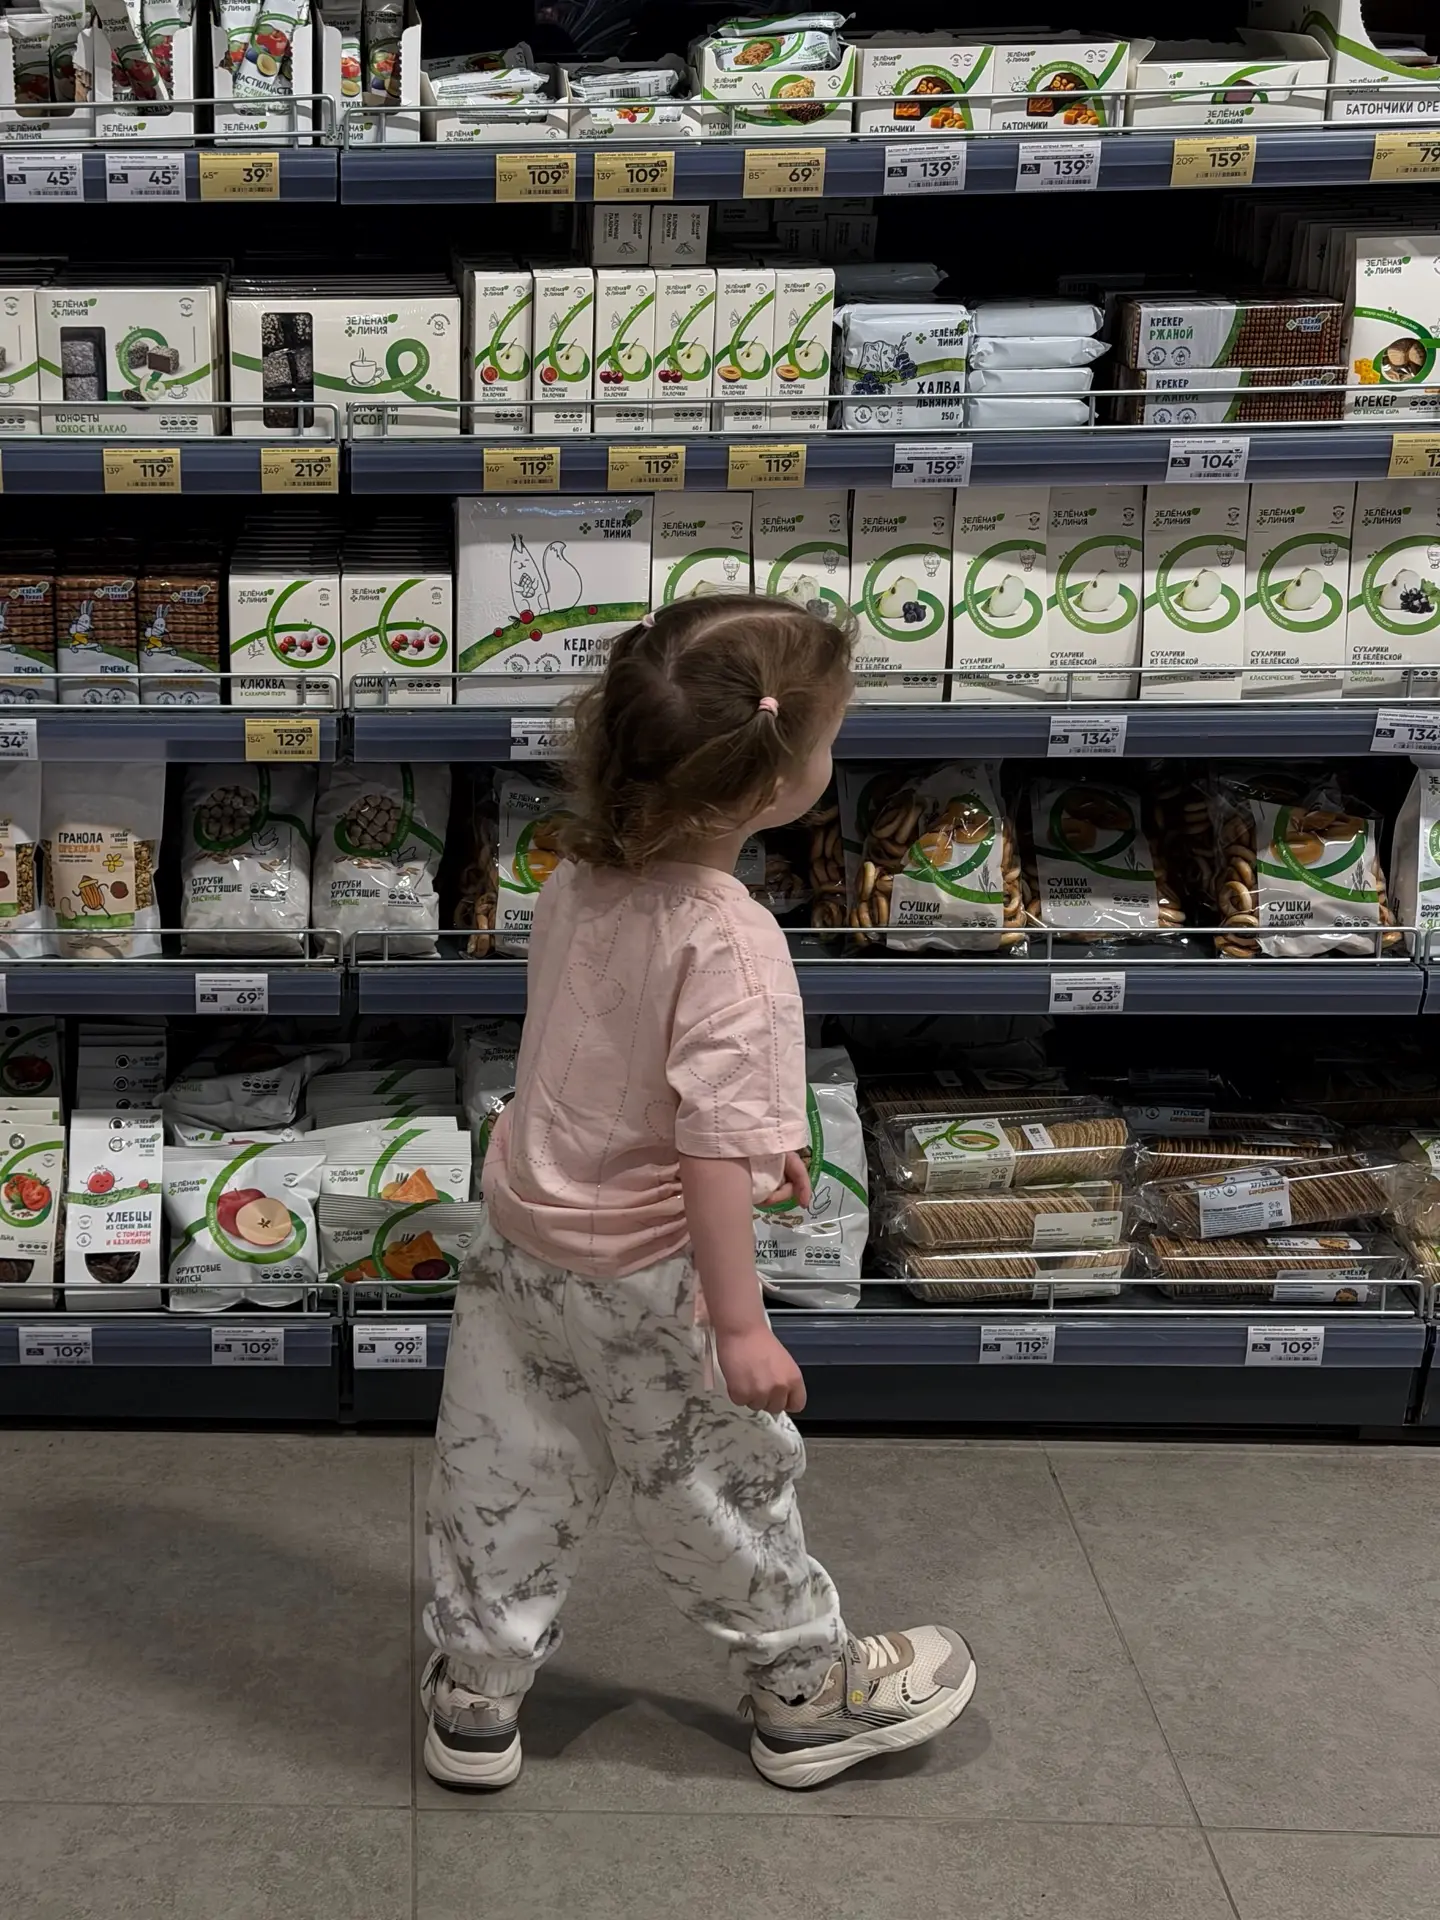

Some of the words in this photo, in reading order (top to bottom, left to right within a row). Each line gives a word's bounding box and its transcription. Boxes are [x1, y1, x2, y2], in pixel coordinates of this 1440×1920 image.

[1207, 110, 1244, 118] ЗЕЛЁНАЯ
[1346, 102, 1414, 116] БАТОНЧИКИ
[6, 122, 42, 132] ЗЕЛЁНАЯ
[102, 124, 138, 132] ЗЕЛЁНАЯ
[223, 123, 258, 131] ЗЕЛЁНАЯ
[1002, 122, 1048, 130] БАТОНЧИКИ
[1209, 152, 1241, 167] 159
[920, 162, 951, 177] 139
[1054, 161, 1085, 175] 139
[47, 172, 69, 185] 45
[149, 171, 171, 185] 45
[243, 168, 265, 182] 39
[529, 171, 561, 184] 109
[627, 168, 660, 182] 109
[788, 168, 812, 182] 69
[1376, 266, 1402, 274] ЛИНИЯ
[52, 300, 88, 308] ЗЕЛЁНАЯ
[61, 308, 88, 316] ЛИНИЯ
[346, 316, 388, 324] ЗЕЛЁНАЯ
[1150, 317, 1183, 327] КРЕКЕР
[356, 326, 388, 335] ЛИНИЯ
[929, 328, 963, 338] ЗЕЛЁНАЯ
[1149, 327, 1193, 340] РЖАНОЙ
[938, 337, 963, 346] ЛИНИЯ
[917, 380, 960, 393] ХАЛВА
[1156, 379, 1189, 389] КРЕКЕР
[1354, 395, 1397, 407] КРЕКЕР
[55, 414, 99, 423] КОНФЕТЫ
[941, 411, 955, 421] 250
[56, 425, 86, 433] КОКОС
[89, 425, 96, 433] И
[98, 424, 127, 433] КАКАО
[766, 460, 792, 472] 119
[1201, 455, 1233, 468] 104
[140, 465, 166, 477] 119
[295, 464, 324, 477] 219
[520, 462, 546, 475] 119
[645, 461, 671, 474] 119
[927, 461, 956, 474] 159
[1052, 510, 1088, 518] ЗЕЛЁНАЯ
[1155, 509, 1191, 518] ЗЕЛЁНАЯ
[1259, 508, 1296, 517] ЗЕЛЁНАЯ
[1364, 508, 1401, 517] ЗЕЛЁНАЯ
[595, 520, 632, 529] ЗЕЛЁНАЯ
[761, 517, 795, 525] ЗЕЛЁНАЯ
[863, 517, 898, 525] ЗЕЛЁНАЯ
[962, 516, 996, 525] ЗЕЛЁНАЯ
[1062, 518, 1088, 526] ЛИНИЯ
[1267, 516, 1295, 524] ЛИНИЯ
[1373, 516, 1401, 525] ЛИНИЯ
[970, 524, 995, 532] ЛИНИЯ
[604, 529, 632, 539] ЛИНИЯ
[1353, 645, 1389, 654] СУХАРИКИ
[855, 656, 890, 664] СУХАРИКИ
[1159, 657, 1198, 665] БЕЛЁВСКОЙ
[1260, 656, 1300, 664] БЕЛЁВСКОЙ
[1352, 653, 1361, 661] ИЗ
[1363, 652, 1402, 661] БЕЛЁВСКОЙ
[100, 665, 129, 673] ПЕЧЕНЬЕ
[240, 678, 285, 690] КЛЮКВА
[277, 734, 305, 746] 129
[1082, 734, 1111, 744] 134
[1408, 729, 1437, 741] 134
[58, 832, 104, 844] ГРАНОЛА
[192, 876, 224, 886] ОТРУБИ
[331, 880, 362, 889] ОТРУБИ
[1047, 878, 1088, 887] СУШКИ
[192, 884, 243, 895] ХРУСТЯЩИЕ
[330, 888, 380, 899] ХРУСТЯЩИЕ
[899, 900, 940, 913] СУШКИ
[1268, 901, 1311, 912] СУШКИ
[1269, 912, 1314, 920] ЛАДОЖСКИЙ
[237, 993, 257, 1004] 69
[1093, 991, 1113, 1002] 63
[169, 1179, 200, 1189] ЗЕЛЁНАЯ
[177, 1185, 200, 1194] ЛИНИЯ
[106, 1211, 152, 1223] ХЛЕБЦЫ
[123, 1230, 151, 1238] ТОМАТОМ
[176, 1263, 222, 1275] ФРУКТОВЫЕ
[175, 1275, 202, 1283] ЧИПСЫ
[54, 1347, 83, 1357] 109
[242, 1343, 271, 1354] 109
[395, 1342, 415, 1354] 99
[1016, 1342, 1042, 1352] 119
[1281, 1342, 1312, 1354] 109
